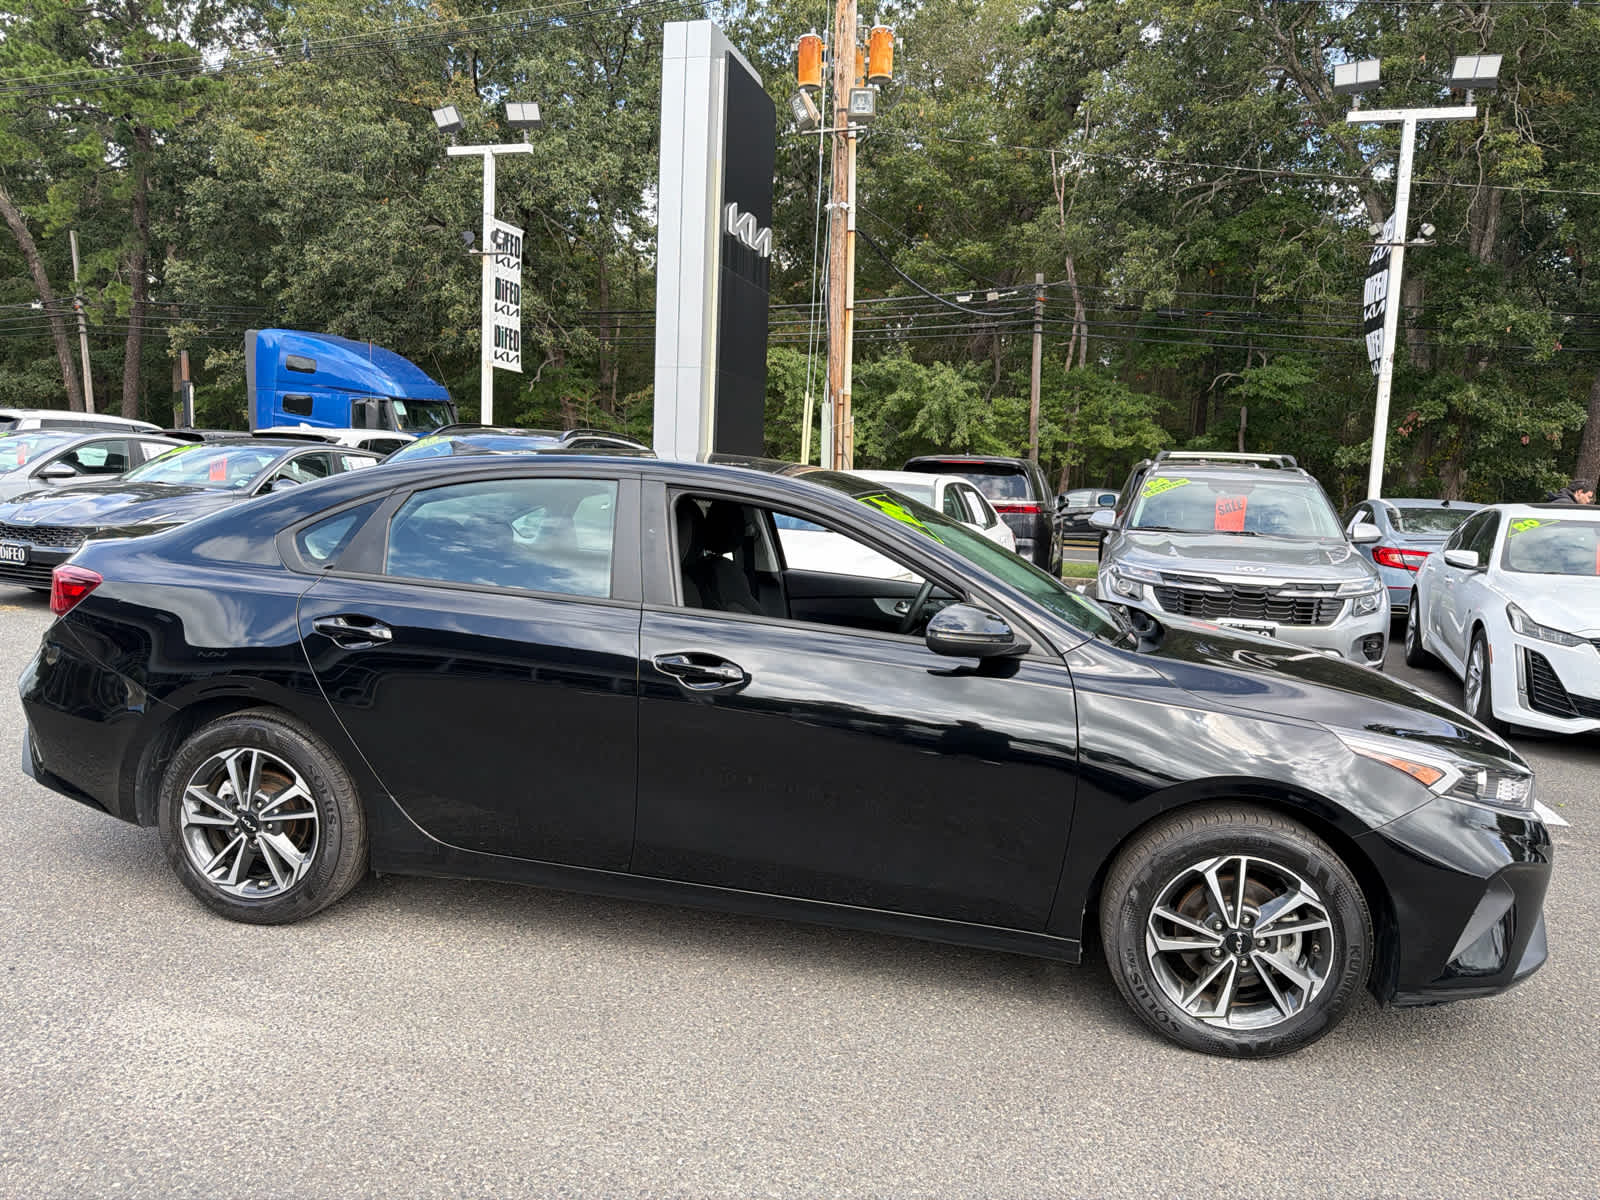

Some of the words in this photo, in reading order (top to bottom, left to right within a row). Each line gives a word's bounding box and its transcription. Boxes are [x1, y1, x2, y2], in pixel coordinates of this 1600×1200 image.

[725, 202, 772, 258] KIA
[495, 254, 521, 271] KIA
[494, 276, 520, 306] DiFEO
[494, 302, 520, 318] KIA
[494, 324, 520, 352] DiFEO
[494, 349, 520, 364] KIA
[1217, 497, 1244, 516] SALE
[0, 546, 25, 562] DiFEO
[1130, 972, 1183, 1034] SOLUS
